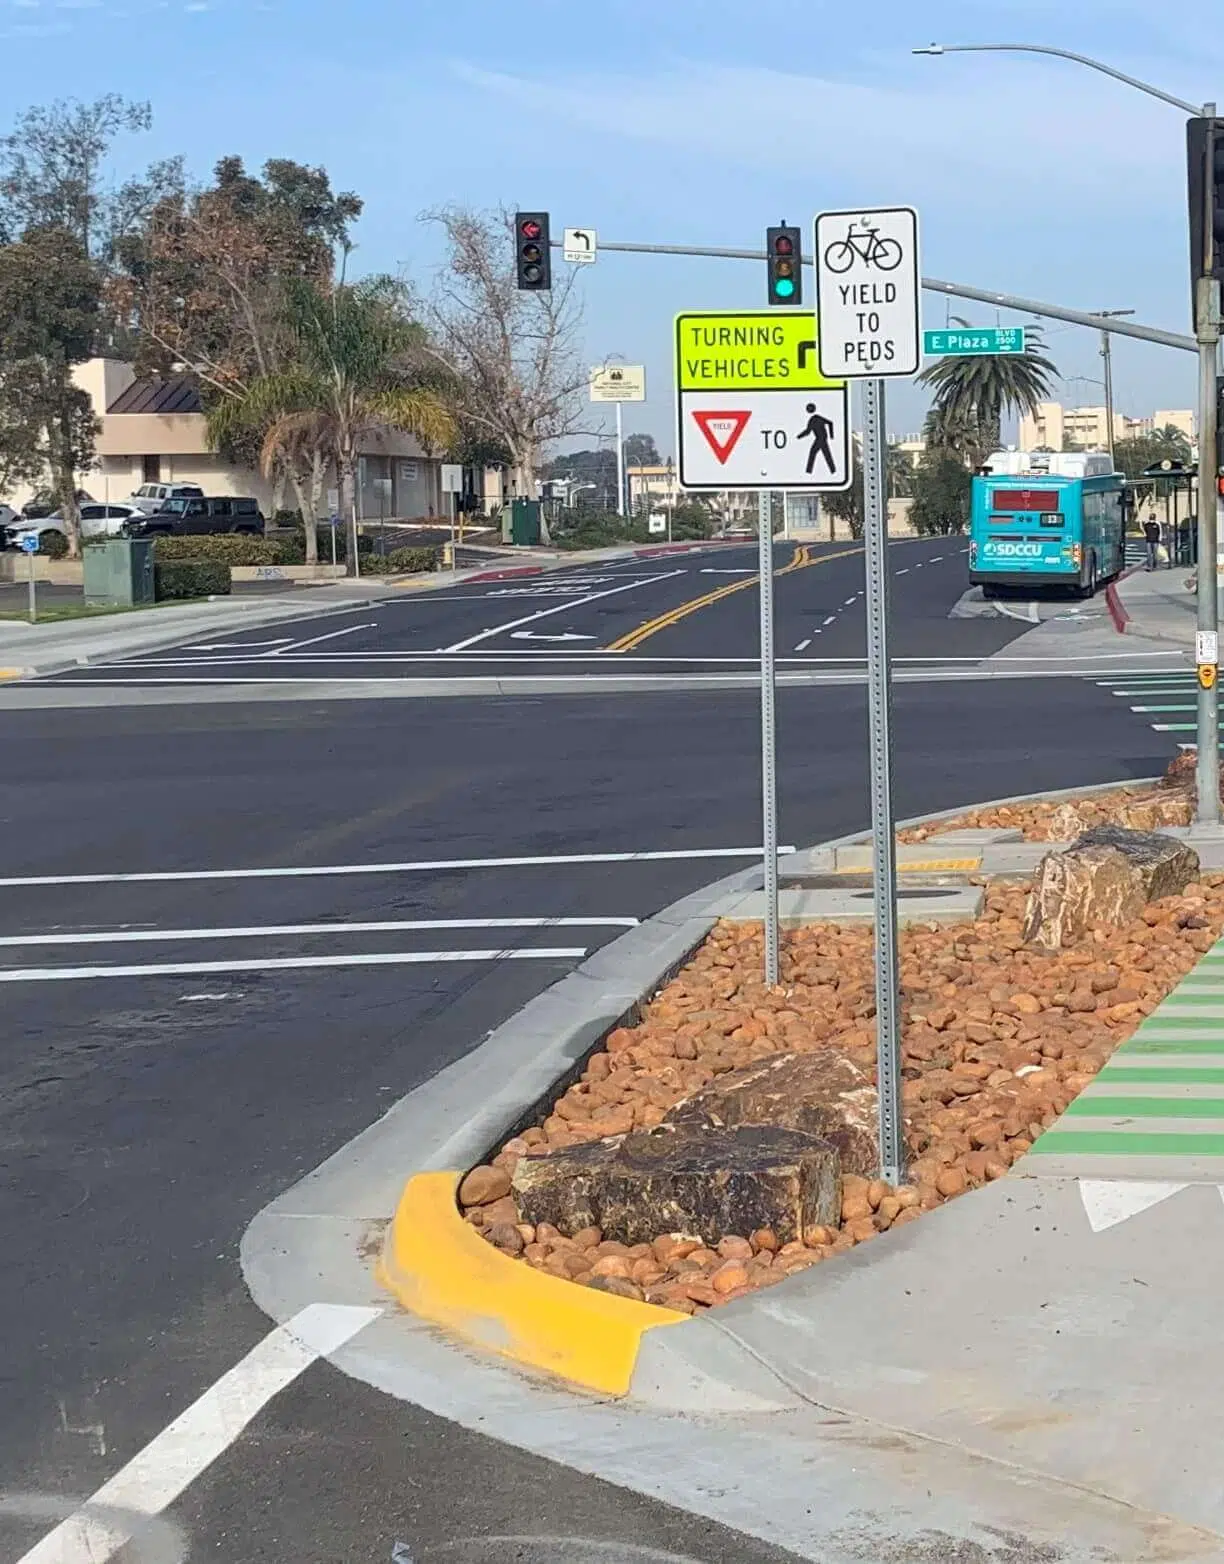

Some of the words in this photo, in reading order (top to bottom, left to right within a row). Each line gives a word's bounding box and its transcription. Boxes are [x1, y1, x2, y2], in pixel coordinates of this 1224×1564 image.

[839, 283, 896, 305] YIELD
[856, 312, 879, 333] TO
[691, 327, 784, 346] TURNING
[948, 335, 989, 349] Plaza
[994, 329, 1016, 337] BLVD
[844, 340, 895, 362] PEDS
[687, 359, 790, 378] VEHICLES
[713, 422, 731, 430] YIELD
[760, 430, 787, 449] TO
[997, 544, 1043, 557] SDCCU
